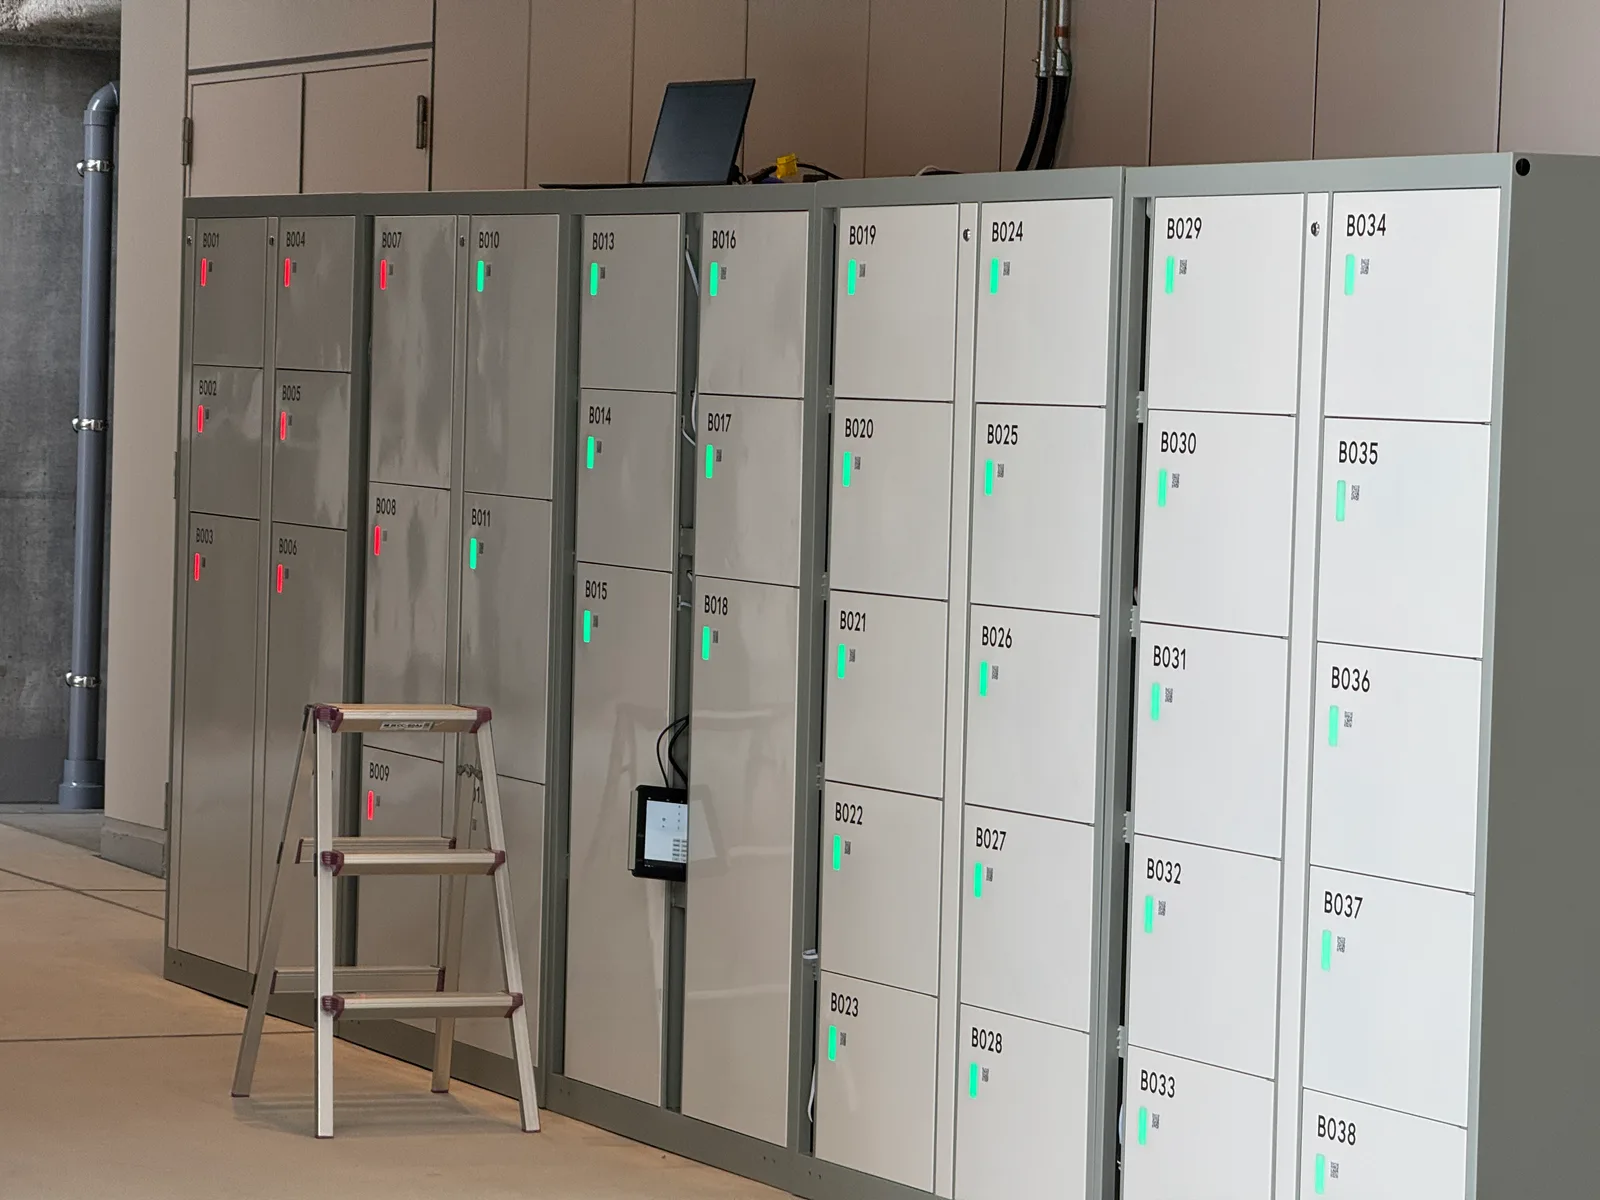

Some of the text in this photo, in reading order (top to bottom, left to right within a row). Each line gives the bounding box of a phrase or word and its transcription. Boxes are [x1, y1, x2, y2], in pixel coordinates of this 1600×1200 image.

[850, 225, 876, 245] B019
[992, 221, 1023, 242] B024
[1167, 217, 1202, 239] B029
[1347, 214, 1386, 236] B034
[203, 232, 219, 248] B001
[287, 231, 305, 247] B004
[382, 232, 402, 248] B007
[479, 231, 499, 248] B010
[593, 232, 614, 250] B013
[712, 230, 736, 249] B016
[200, 380, 217, 396] B002
[282, 385, 301, 401] B005
[589, 406, 611, 424] B014
[708, 413, 731, 432] B017
[845, 418, 873, 438] B020
[988, 424, 1018, 445] B025
[1161, 431, 1196, 454] B030
[1339, 441, 1378, 465] B035
[376, 498, 396, 515] B008
[472, 508, 490, 527] B011
[196, 528, 213, 544] B003
[279, 538, 297, 555] B006
[586, 580, 607, 600] B015
[705, 595, 728, 615] B018
[840, 611, 865, 632] B021
[982, 626, 1012, 648] B026
[1154, 645, 1186, 669] B031
[1332, 666, 1370, 692] B036
[370, 762, 389, 781] B009
[836, 802, 862, 825] B022
[976, 827, 1006, 851] B027
[1147, 858, 1181, 884] B032
[1324, 891, 1363, 919] B037
[831, 992, 858, 1017] B023
[972, 1027, 1002, 1053] B028
[1141, 1070, 1175, 1098] B033
[1318, 1115, 1355, 1145] B038
